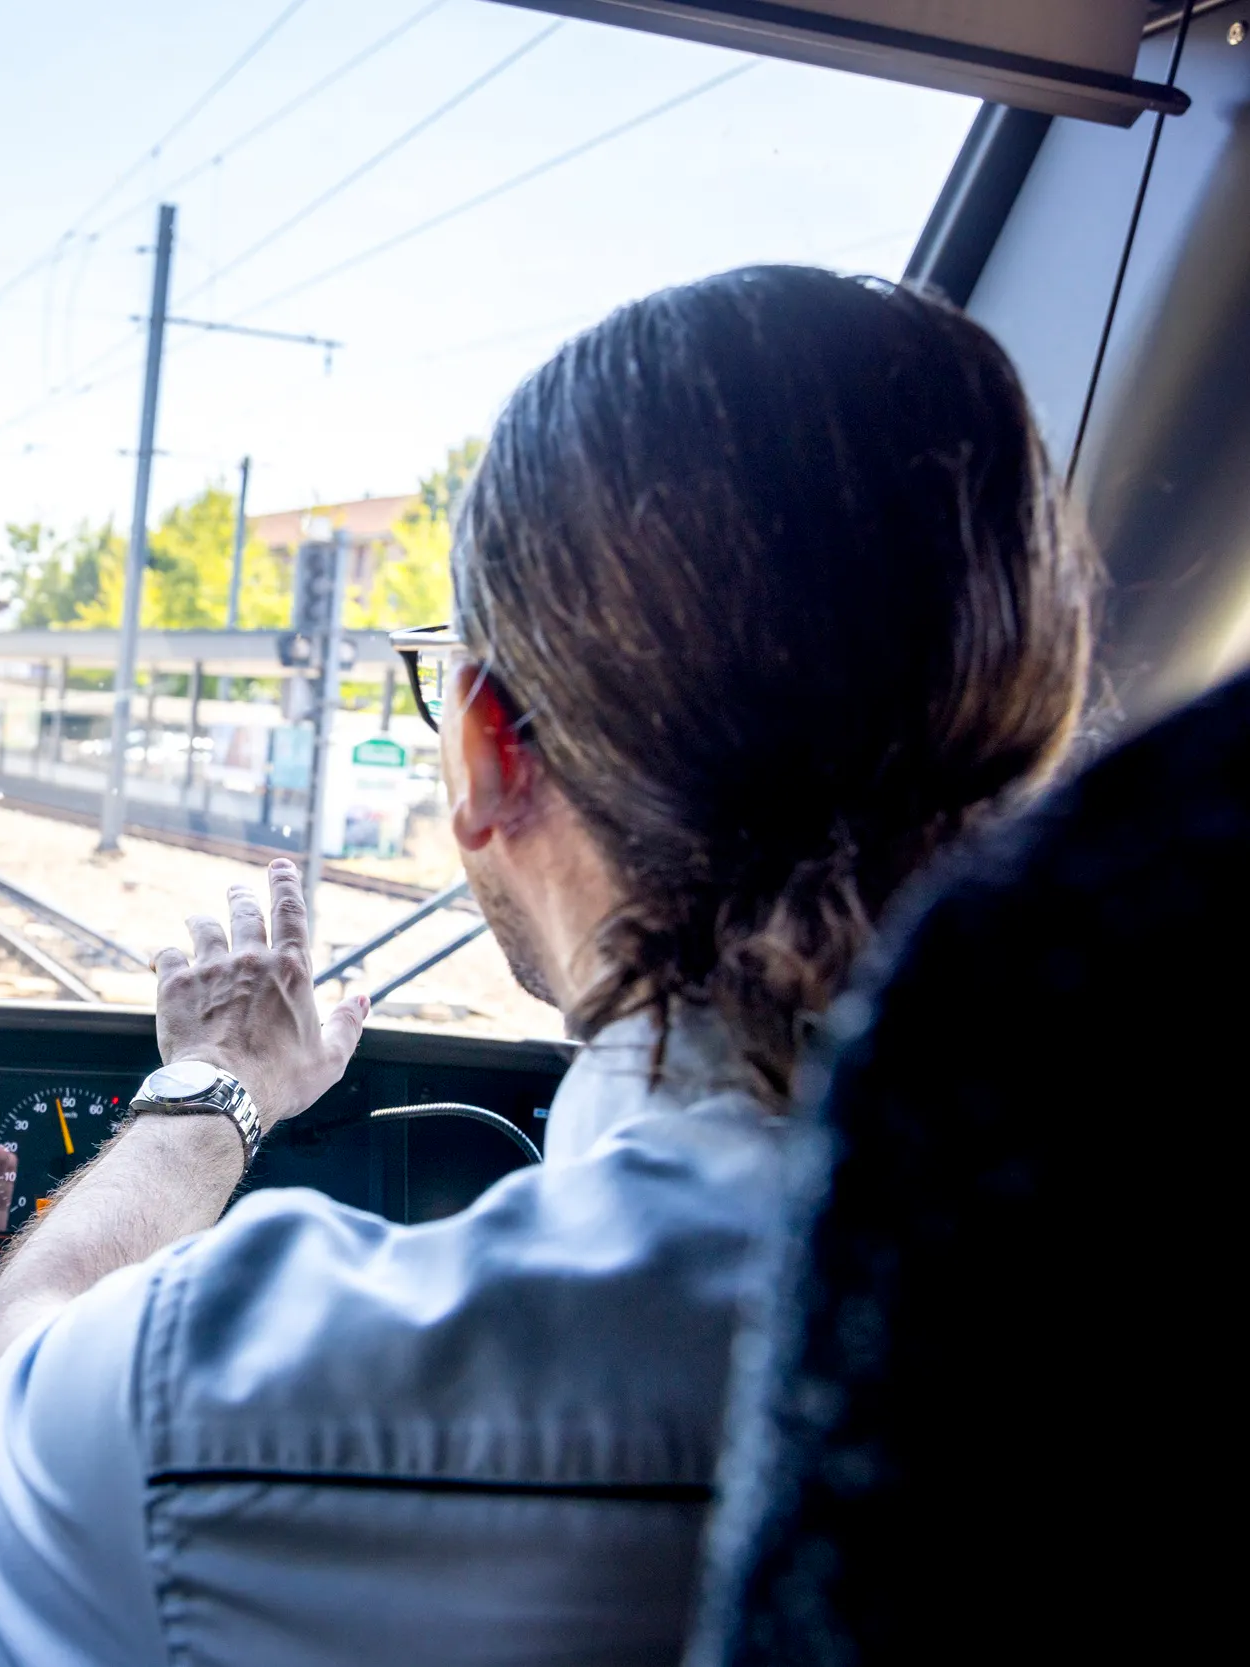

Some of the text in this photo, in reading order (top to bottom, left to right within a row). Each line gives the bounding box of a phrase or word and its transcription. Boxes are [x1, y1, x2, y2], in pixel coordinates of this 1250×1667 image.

[33, 1102, 47, 1113] 40
[62, 1097, 76, 1108] 50
[89, 1104, 103, 1115] 60
[13, 1119, 29, 1131] 30
[4, 1142, 18, 1152] 20
[4, 1171, 17, 1182] 10
[18, 1196, 27, 1207] 0
